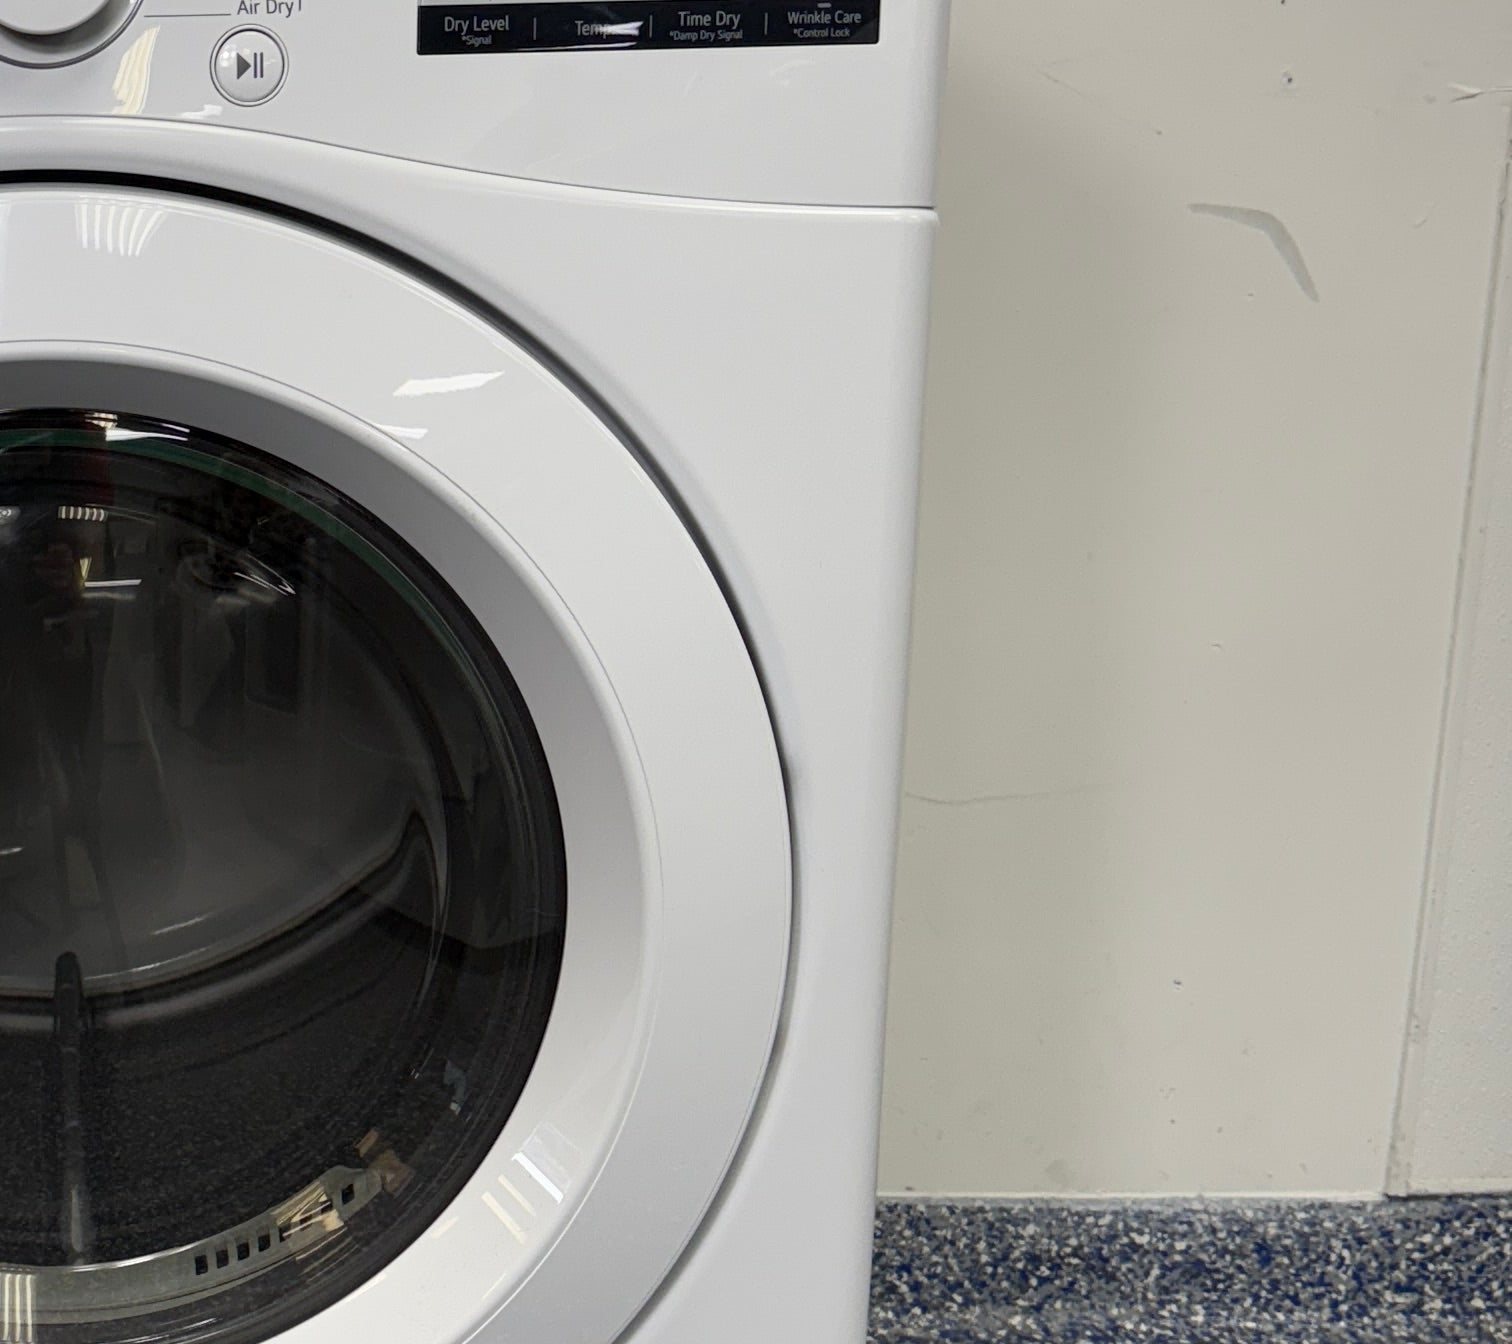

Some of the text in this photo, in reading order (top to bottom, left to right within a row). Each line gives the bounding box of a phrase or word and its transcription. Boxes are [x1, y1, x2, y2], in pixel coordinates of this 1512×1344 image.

[237, 0, 260, 16] Air
[678, 10, 741, 29] Time Dry
[788, 11, 862, 24] Wrinkle Care
[444, 15, 510, 35] Dry Level
[831, 27, 850, 37] Lock
[700, 30, 715, 42] Dry
[718, 29, 743, 40] Signal
